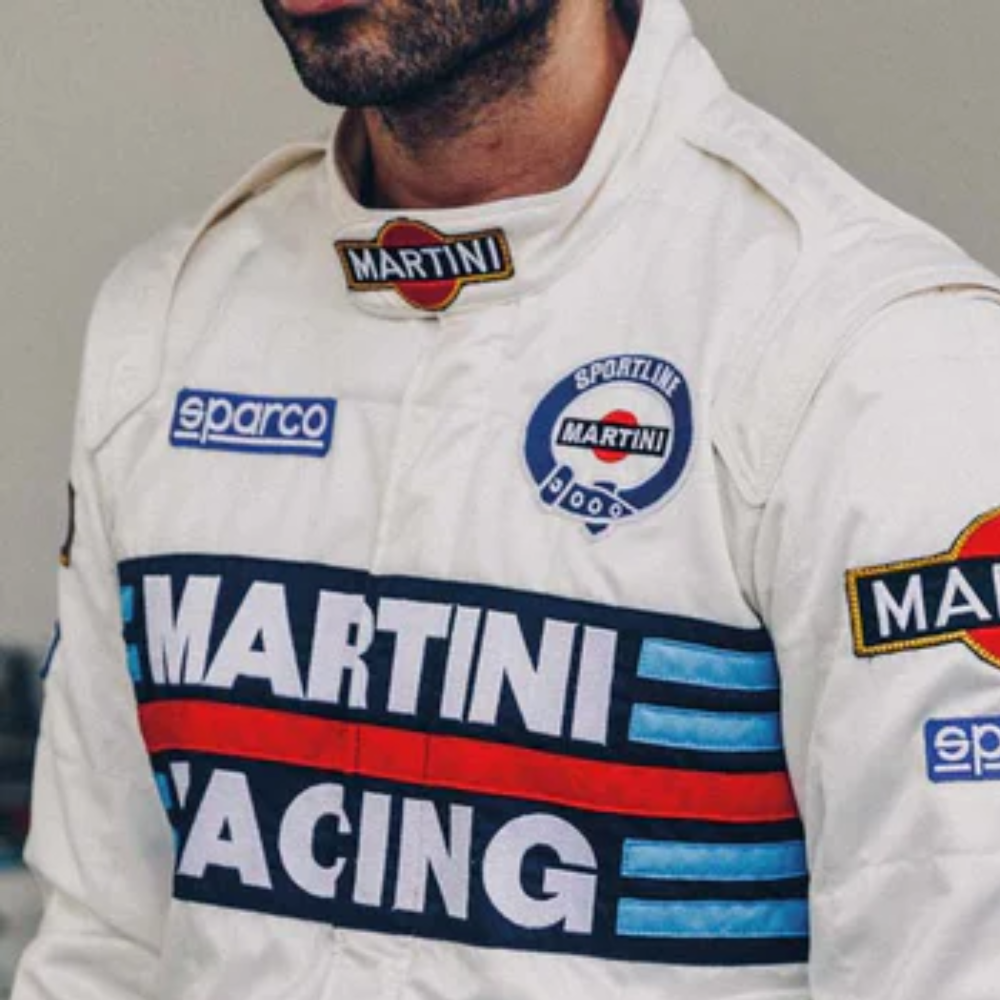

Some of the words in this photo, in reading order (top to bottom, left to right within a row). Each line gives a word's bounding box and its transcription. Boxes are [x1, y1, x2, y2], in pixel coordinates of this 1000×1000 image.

[348, 236, 502, 282] MARTINI
[574, 355, 681, 397] SPORTLINE
[176, 394, 328, 445] sparco
[561, 421, 665, 453] MARTINI
[141, 573, 618, 746] MARTINI
[169, 759, 599, 935] ACING
